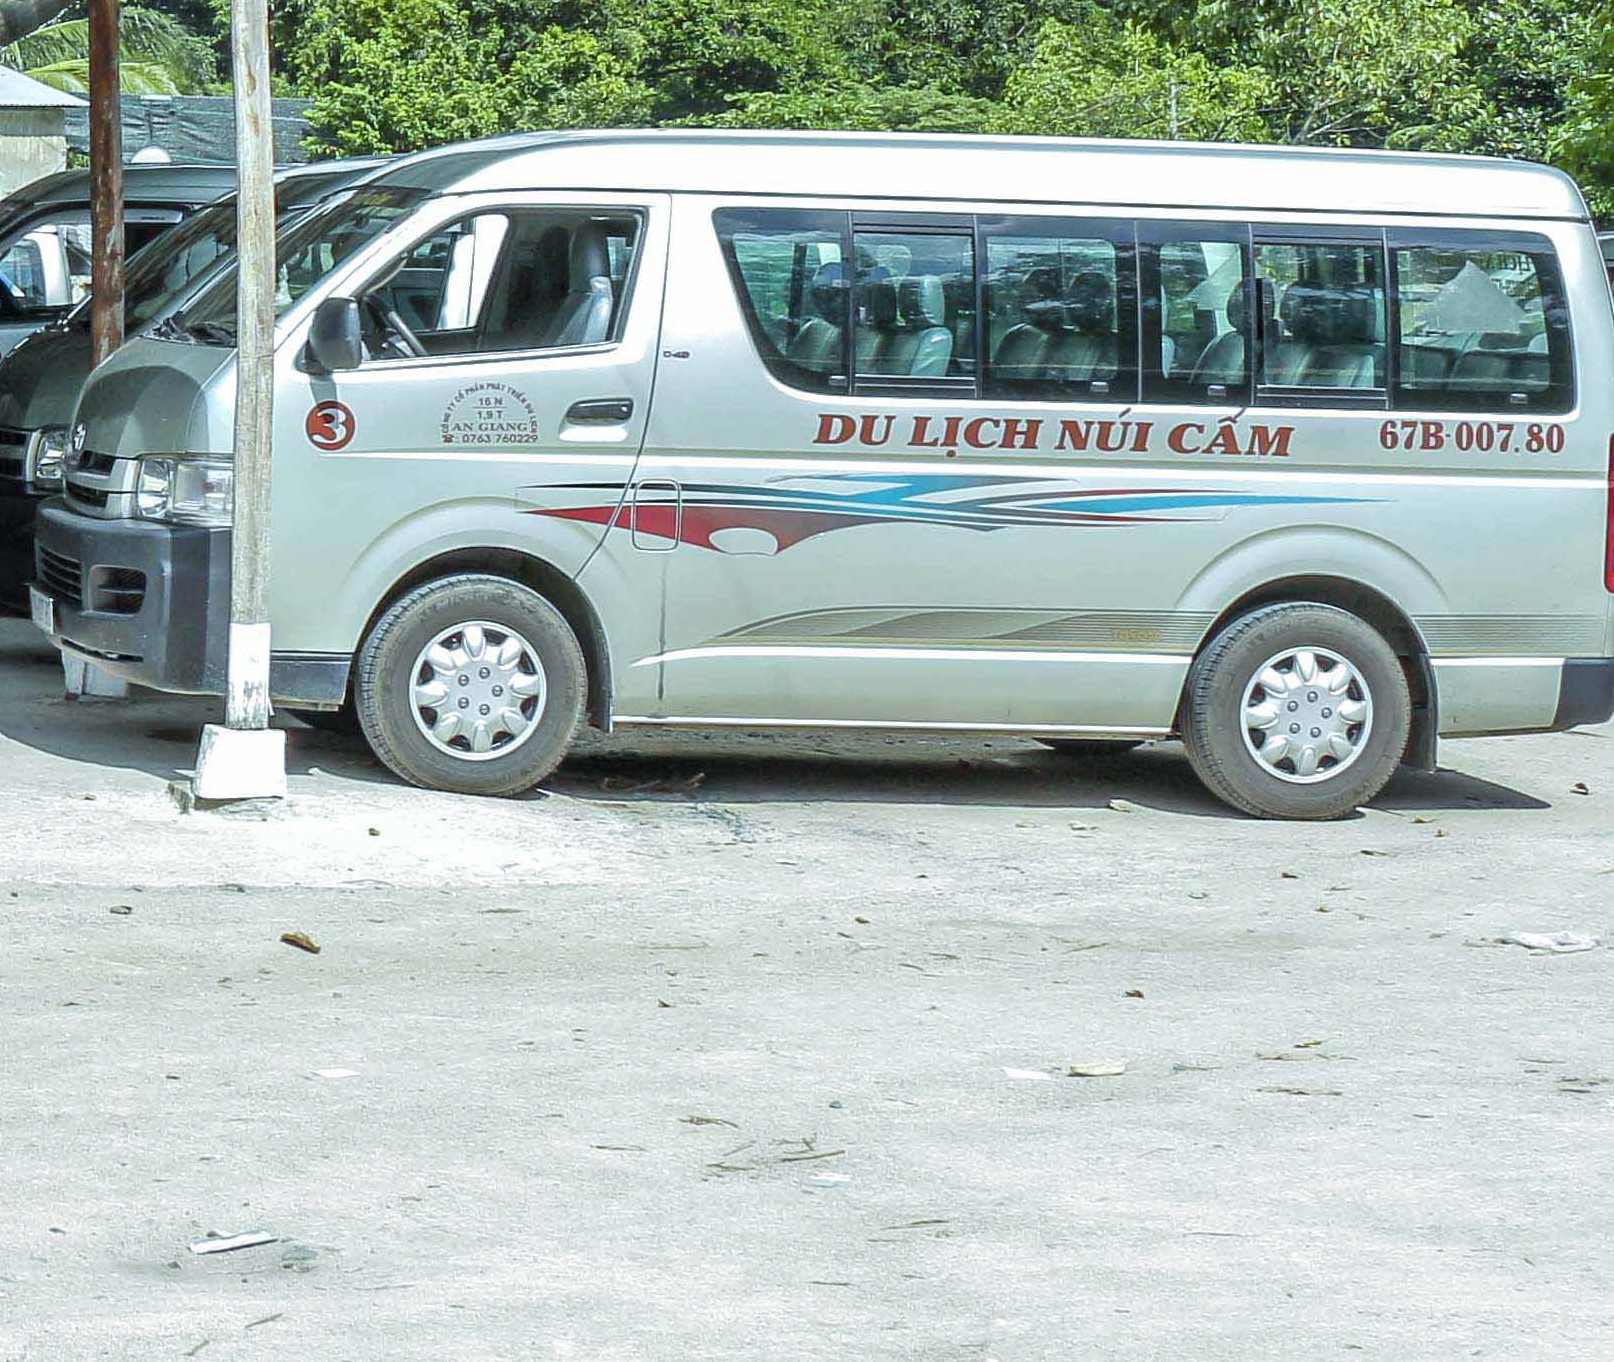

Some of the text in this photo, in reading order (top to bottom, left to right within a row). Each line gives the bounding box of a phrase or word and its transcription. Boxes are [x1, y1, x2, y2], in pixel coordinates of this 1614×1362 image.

[478, 397, 503, 406] 16 N
[314, 406, 354, 446] 3
[452, 422, 527, 431] AN GIANG
[812, 407, 1295, 458] DU LỊCH NÚI CẤM
[462, 434, 538, 443] 0763 760229
[1380, 421, 1565, 453] 67B-007.80
